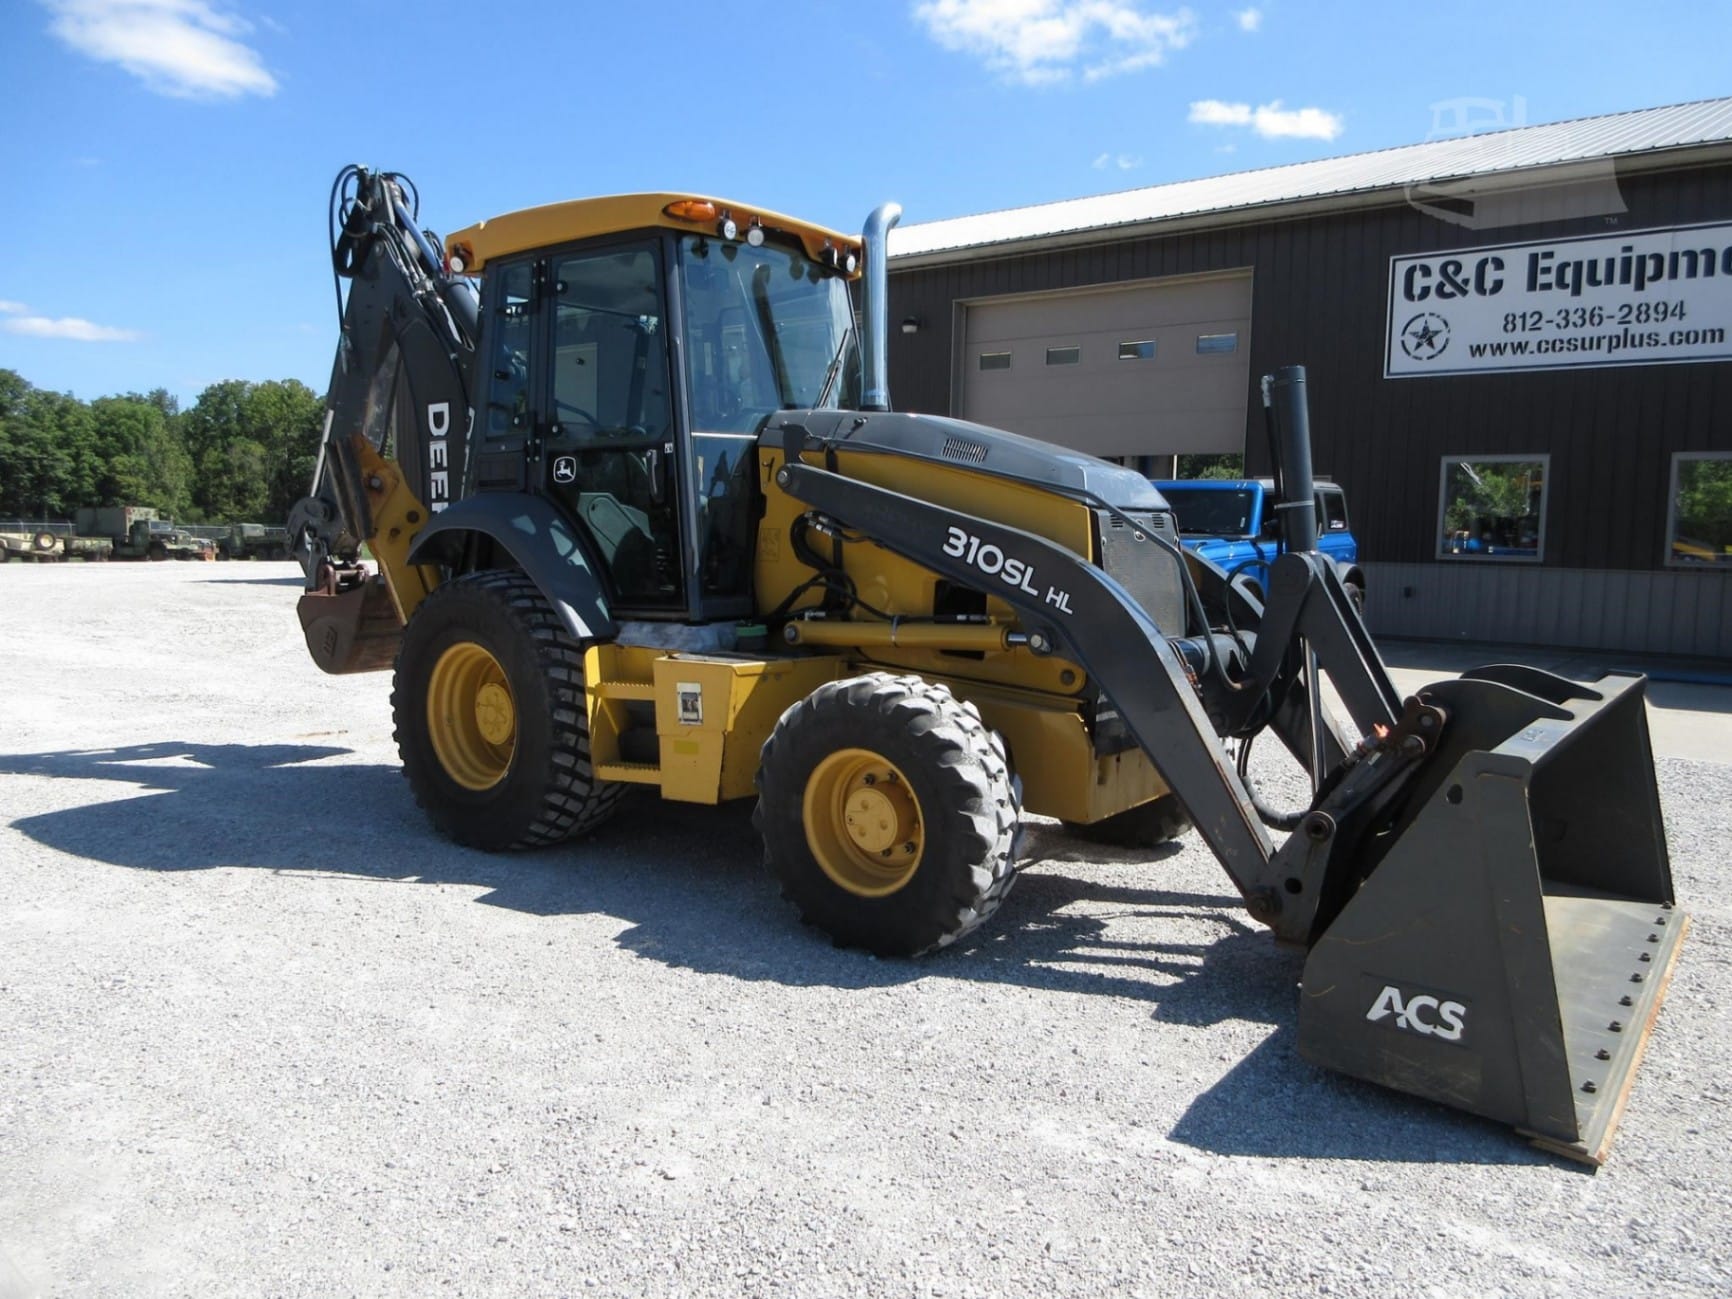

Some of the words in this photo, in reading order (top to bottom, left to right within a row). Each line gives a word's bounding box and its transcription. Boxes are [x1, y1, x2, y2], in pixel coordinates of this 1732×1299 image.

[1403, 256, 1505, 302] C&C
[1502, 299, 1687, 333] 812-336-2894
[1469, 327, 1725, 359] www.ccsurplus.com
[941, 525, 1039, 597] 310SL
[1045, 585, 1073, 616] HL
[1366, 985, 1466, 1041] ACS
